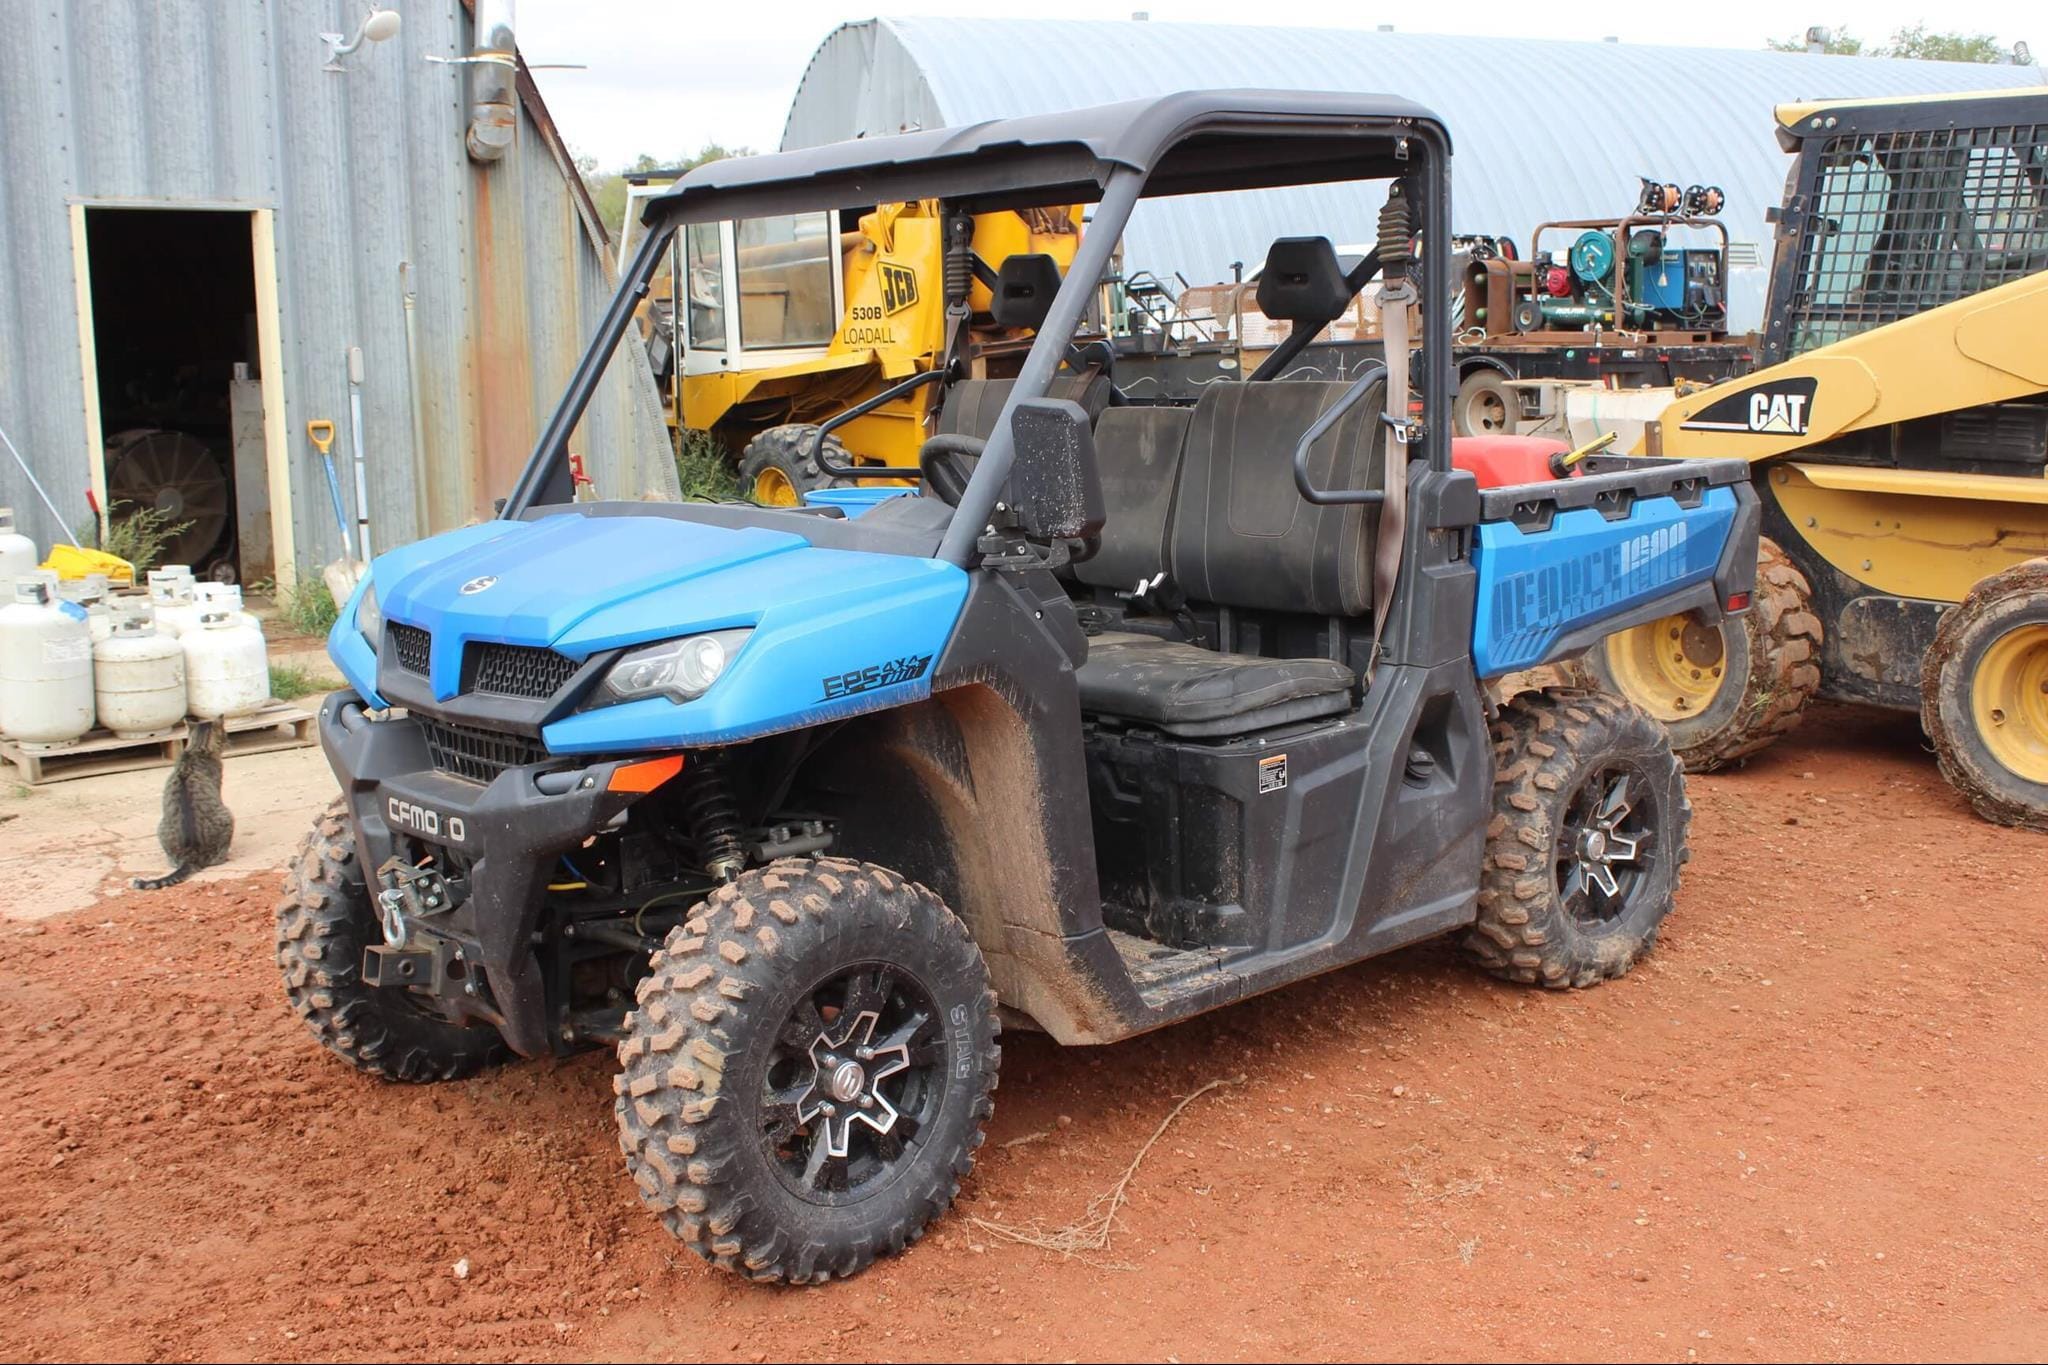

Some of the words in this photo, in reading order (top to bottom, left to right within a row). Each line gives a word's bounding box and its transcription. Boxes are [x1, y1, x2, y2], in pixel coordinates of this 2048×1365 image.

[882, 266, 915, 313] JCB
[852, 306, 882, 320] 530B
[843, 327, 896, 345] LOADALL
[1749, 393, 1807, 433] CAT
[822, 665, 881, 698] EPS
[388, 797, 465, 842] CFMOO
